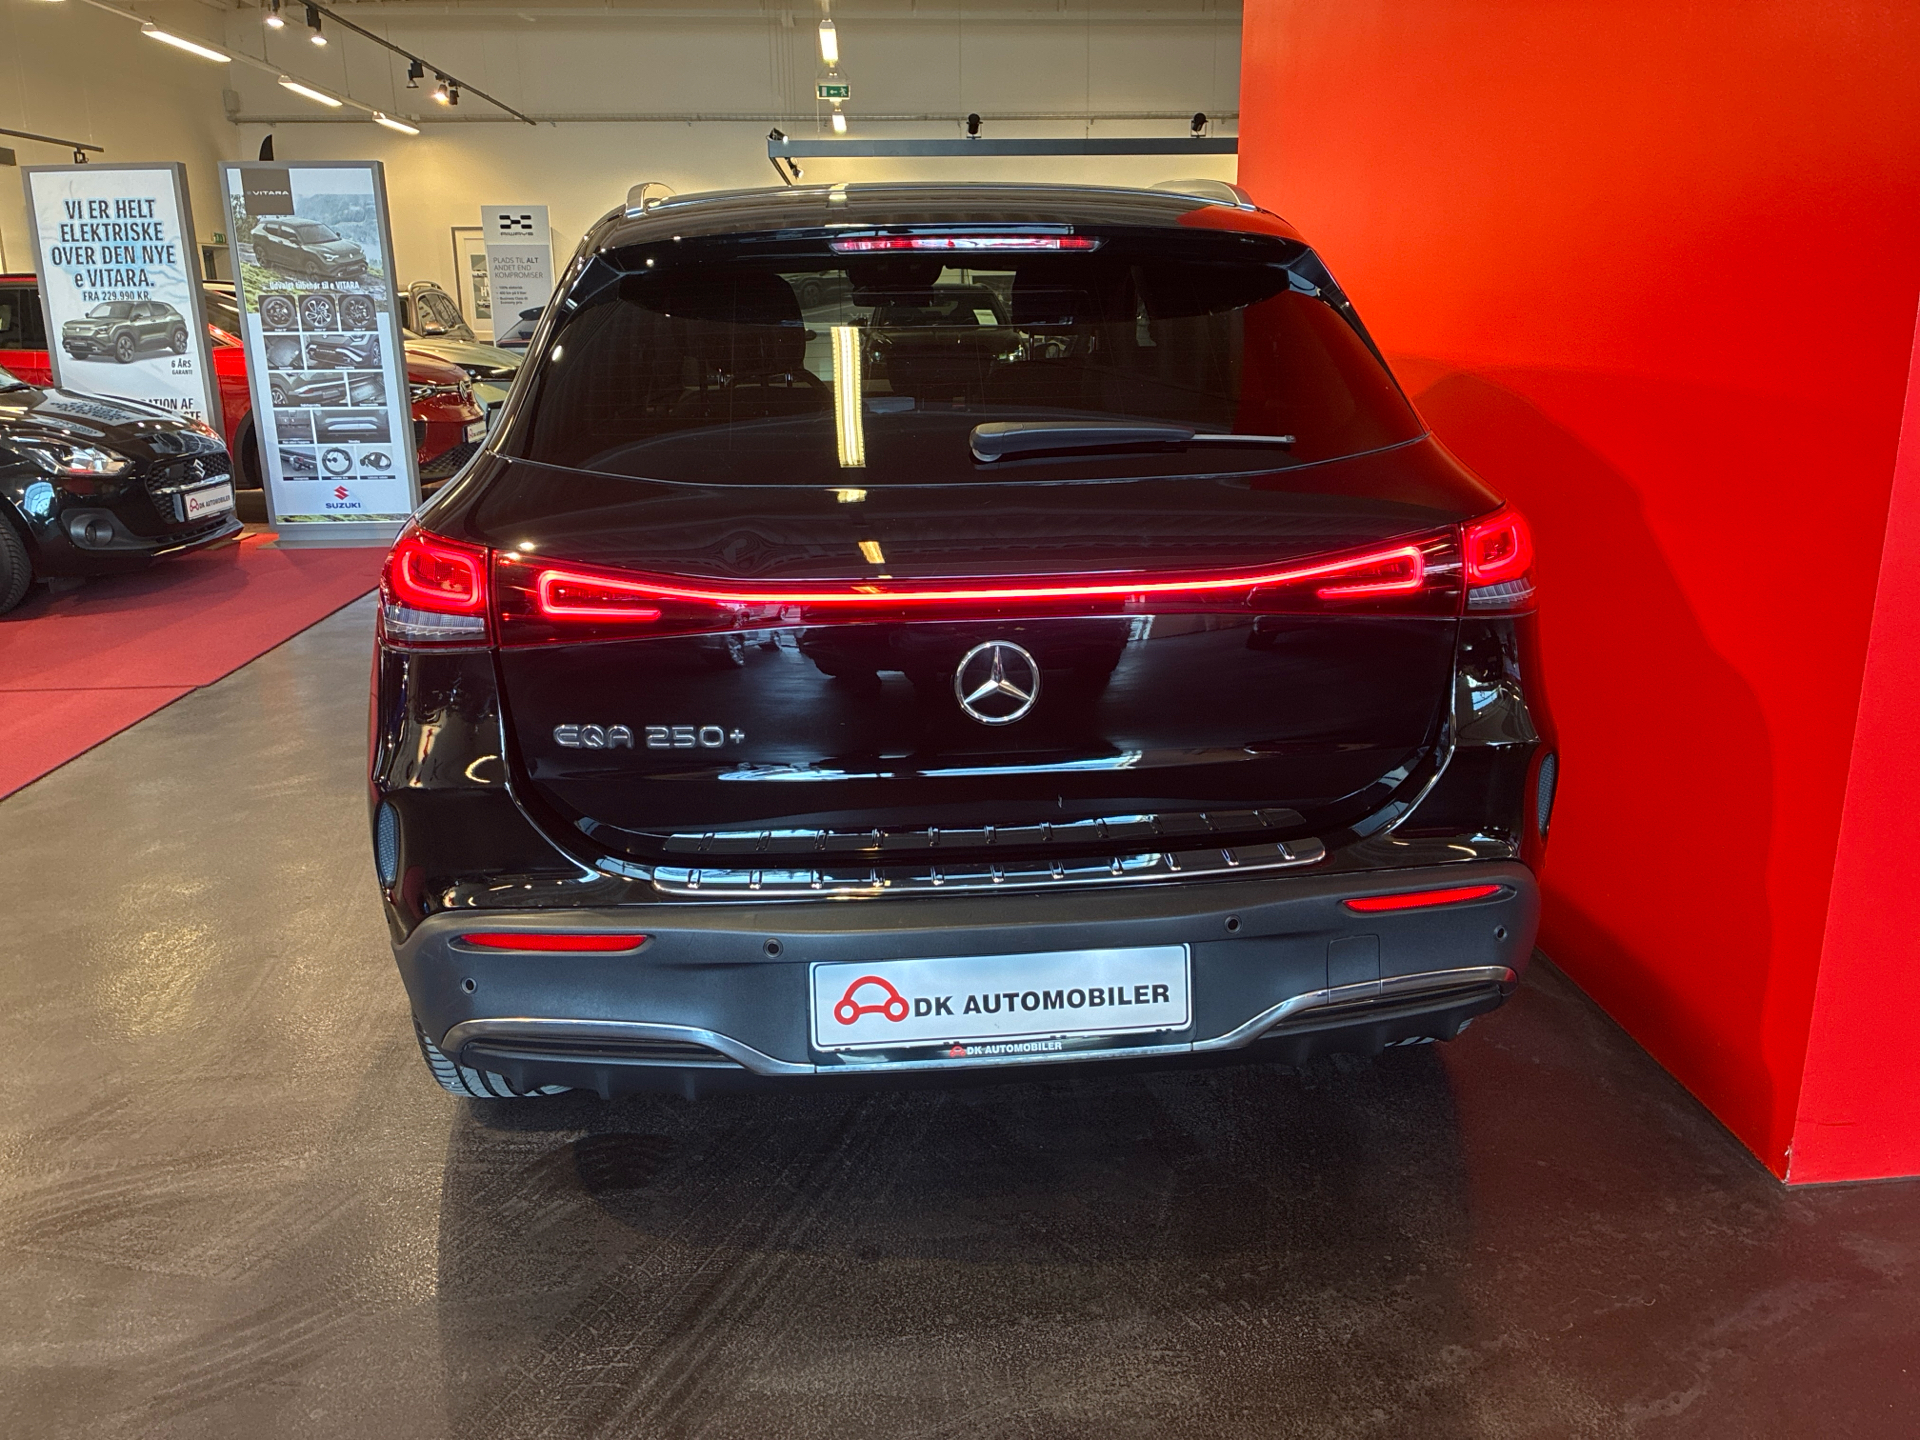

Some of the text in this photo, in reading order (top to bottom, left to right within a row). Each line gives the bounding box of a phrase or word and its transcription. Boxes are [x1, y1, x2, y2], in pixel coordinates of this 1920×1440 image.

[65, 199, 155, 219] VI ER HELT
[60, 222, 164, 243] ELEKTRISKE
[51, 245, 176, 266] OVER DEN NYE
[74, 268, 155, 288] e VITARA.
[335, 281, 360, 290] VITARA
[83, 290, 152, 301] FRA 229.990 KR.
[171, 358, 192, 368] 6 ÅRS
[181, 398, 194, 410] AF
[553, 724, 746, 749] EQA 250+
[914, 984, 1170, 1017] DK AUTOMOBILER
[966, 1041, 1063, 1056] DK AUTOMOBILER
